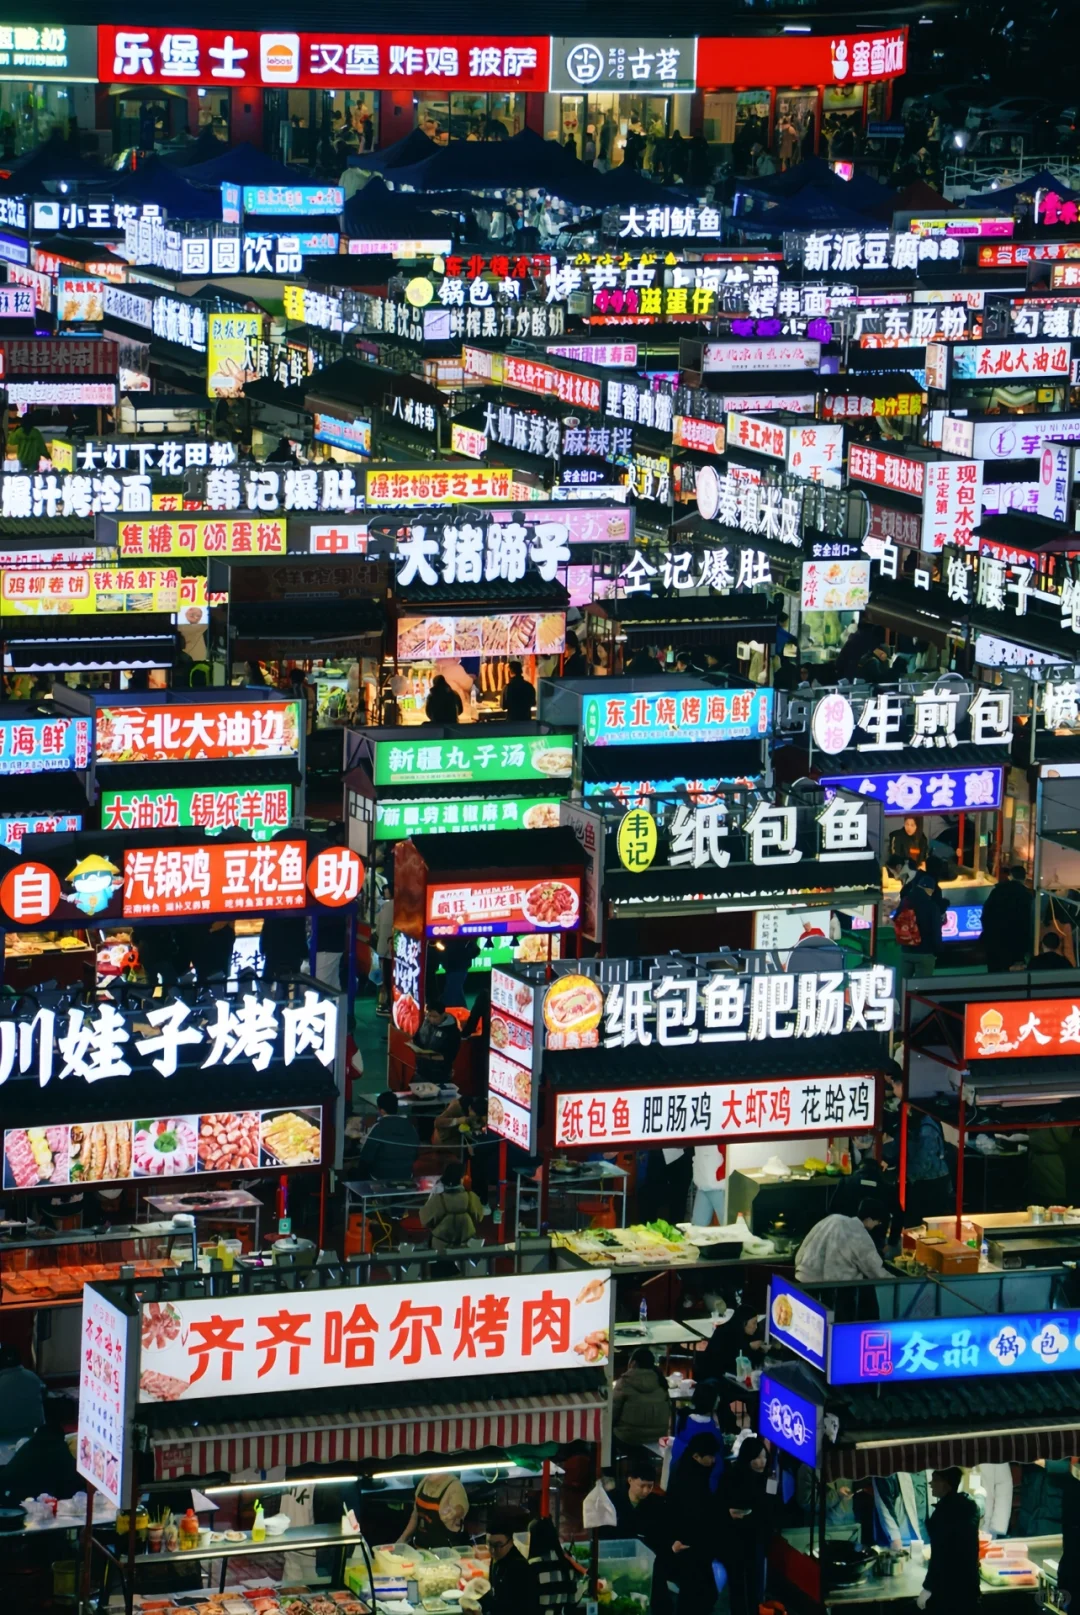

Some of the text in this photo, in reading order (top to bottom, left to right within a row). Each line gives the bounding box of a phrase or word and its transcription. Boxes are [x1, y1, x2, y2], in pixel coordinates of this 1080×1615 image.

[113, 33, 248, 79] 乐堡士
[310, 44, 537, 77] 汉堡 炸鸡 披萨
[628, 48, 680, 80] 古茗
[62, 202, 163, 230] 小王饮品
[619, 206, 721, 239] 大利鱿鱼
[182, 236, 303, 276] 圆圆饮品
[804, 232, 919, 271] 新派豆腐
[437, 276, 520, 307] 锅包肉
[451, 306, 564, 338] 鲜榨果汁炒酸奶
[854, 307, 967, 341] 广东肠粉
[609, 346, 636, 363] 寿司
[977, 346, 1068, 375] 东北大油边
[563, 426, 633, 456] 麻辣拌
[738, 420, 785, 457] 手工水饺
[2, 474, 152, 518] 爆汁烤冷面
[206, 468, 357, 511] 韩记爆肚
[369, 472, 509, 499] 爆浆榴莲芝士饼
[563, 470, 598, 483] 安全出口
[935, 467, 951, 547] 正定第一家
[957, 465, 979, 548] 现包水饺
[121, 522, 282, 555] 焦糖可颂蛋挞
[396, 522, 571, 587] 大猪蹄子
[813, 544, 850, 558] 安全出口
[8, 570, 178, 594] 鸡柳卷饼 铁板虾滑
[620, 548, 773, 593] 全记爆肚
[112, 709, 285, 752] 东北大油边
[605, 694, 753, 728] 东北烧烤海鲜
[857, 687, 1014, 753] 生煎包
[388, 743, 526, 772] 新疆丸子汤
[105, 789, 289, 831] 大油边 锡纸羊腿
[626, 813, 650, 867] 韦记
[667, 797, 876, 869] 纸包鱼
[14, 866, 52, 919] 自
[125, 843, 305, 902] 汽锅鸡 豆花鱼
[313, 850, 360, 902] 助
[603, 964, 894, 1048] 纸包鱼肥肠鸡
[561, 1081, 869, 1138] 纸包鱼 肥肠鸡 大虾鸡 花蛤鸡
[188, 1289, 571, 1385] 齐齐哈尔烤肉
[895, 1329, 980, 1373] 众品
